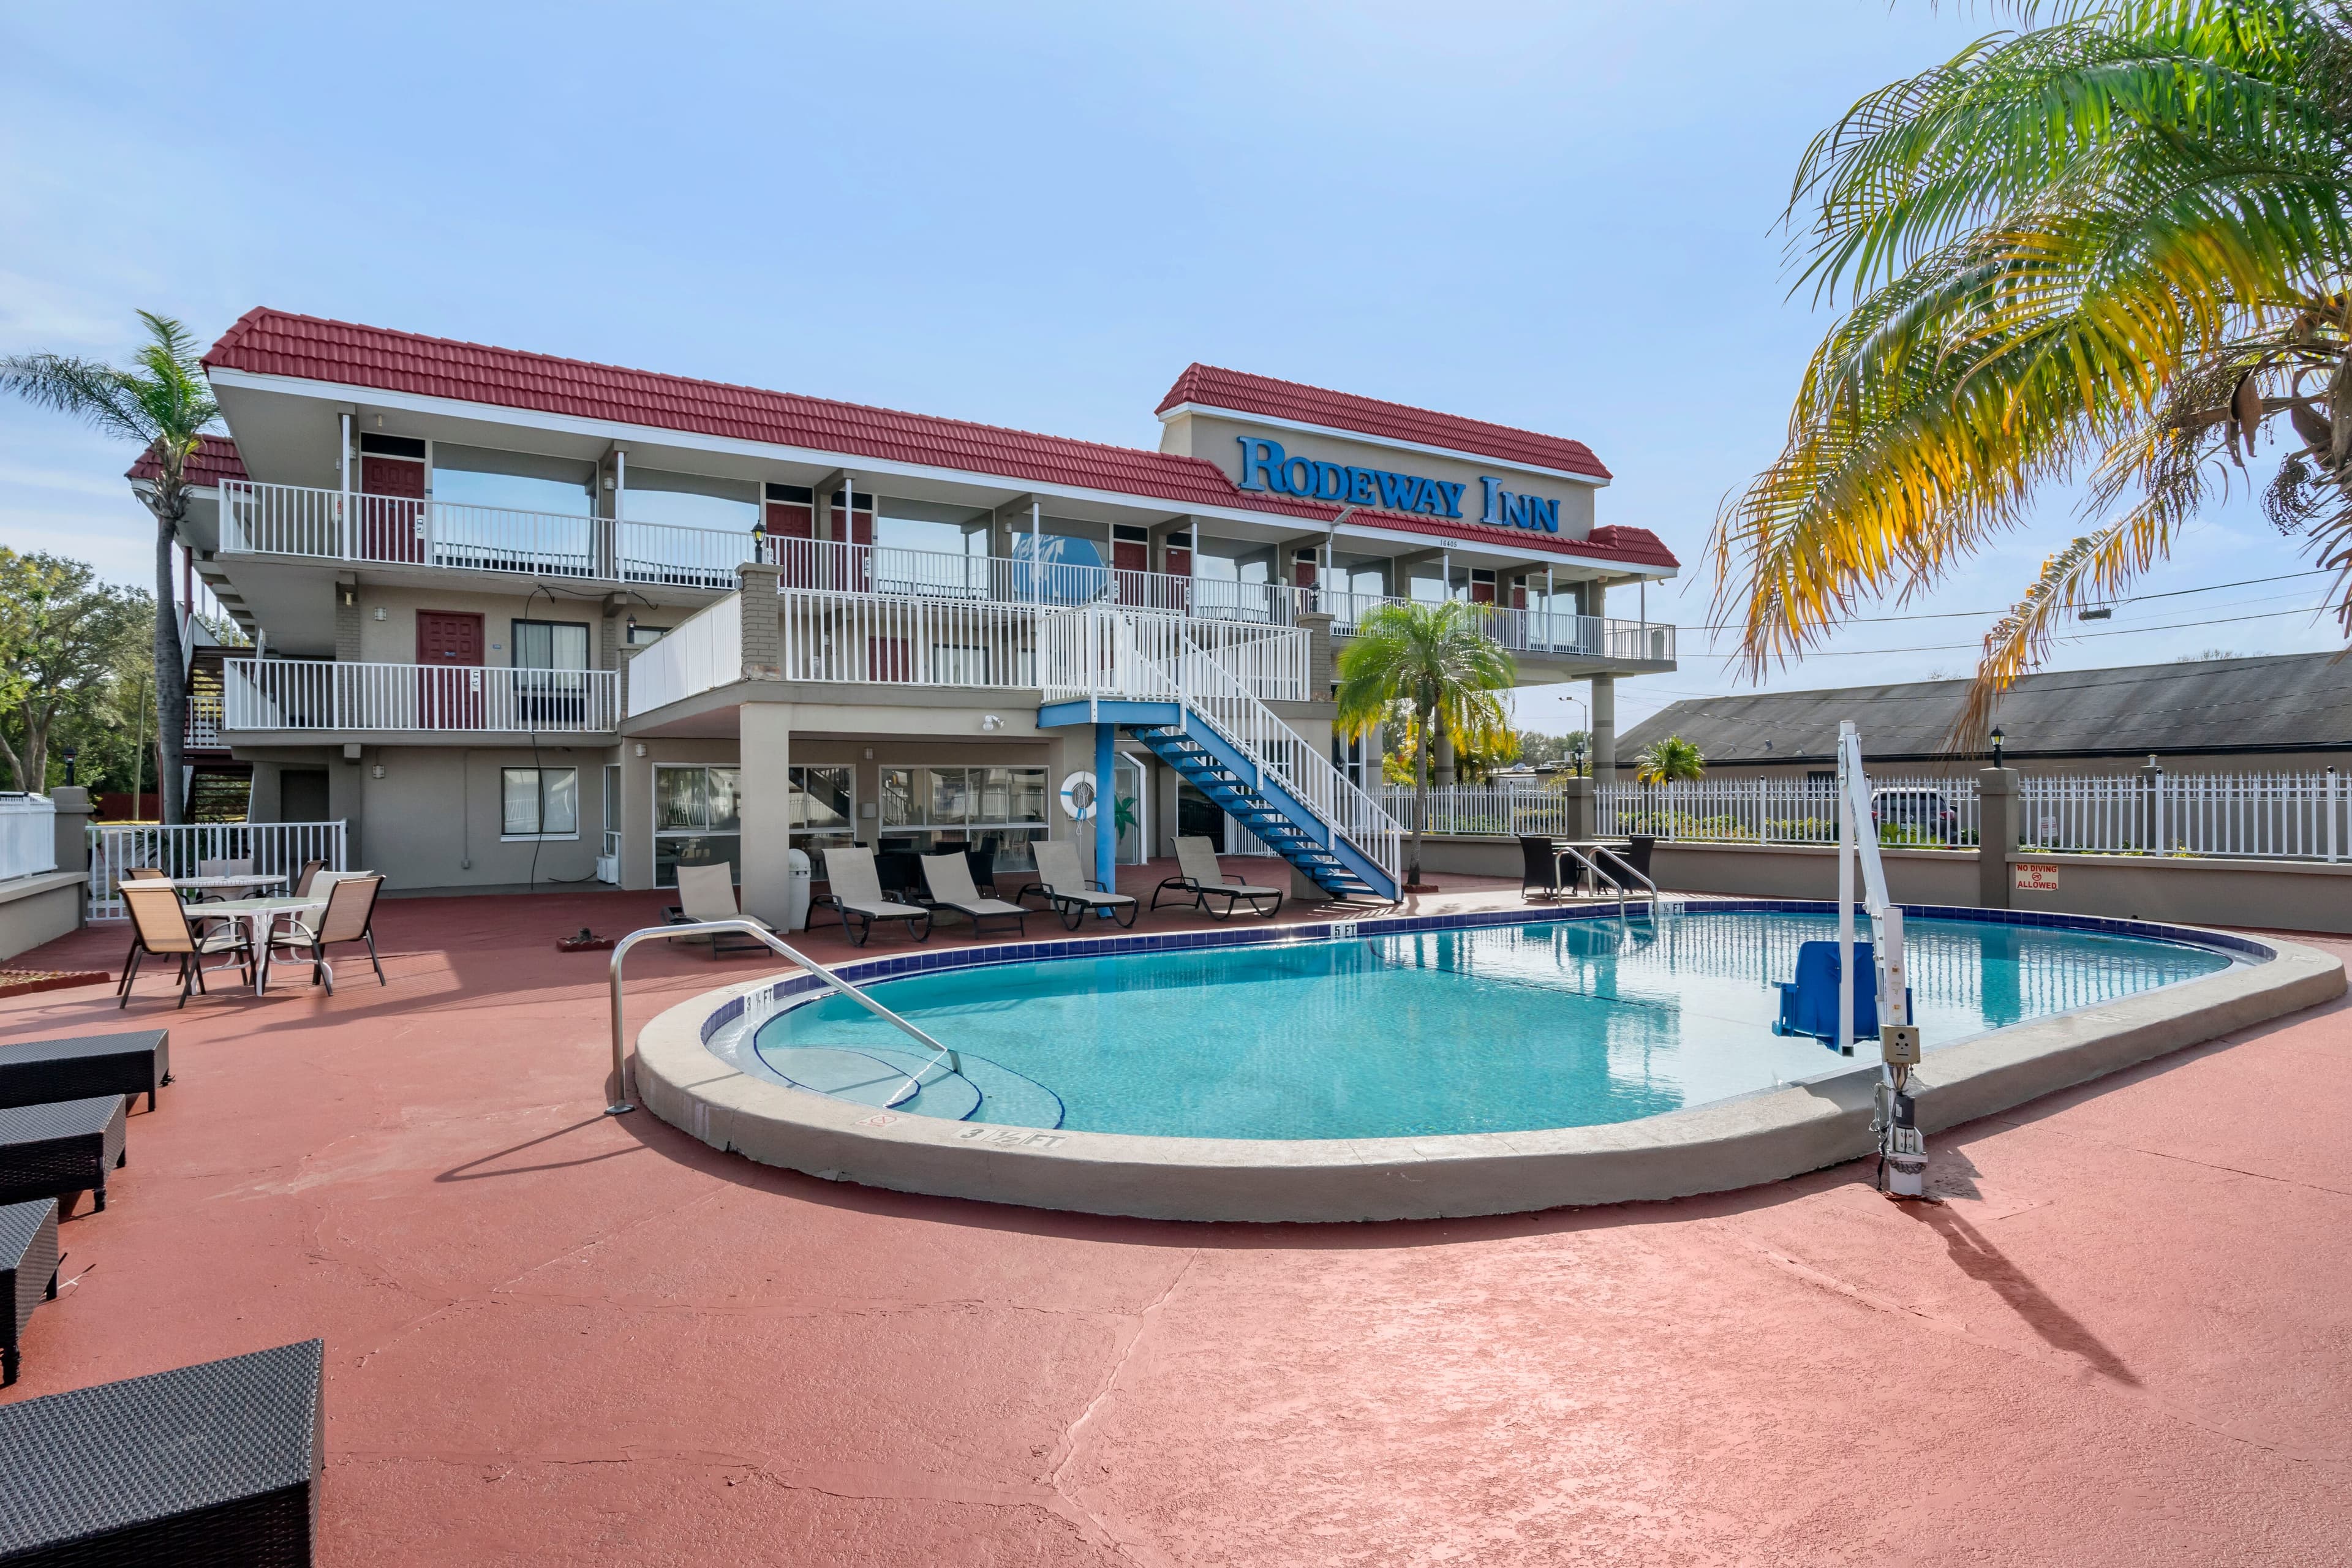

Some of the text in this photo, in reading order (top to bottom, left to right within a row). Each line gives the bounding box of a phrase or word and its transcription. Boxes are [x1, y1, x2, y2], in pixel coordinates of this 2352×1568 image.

[1236, 435, 1561, 532] RODEWAY INN
[1673, 903, 1683, 913] FT
[1335, 924, 1355, 937] 5 FT
[747, 997, 751, 1011] 3
[764, 988, 772, 1005] FT
[960, 1129, 984, 1138] 3
[1023, 1134, 1066, 1147] FT
